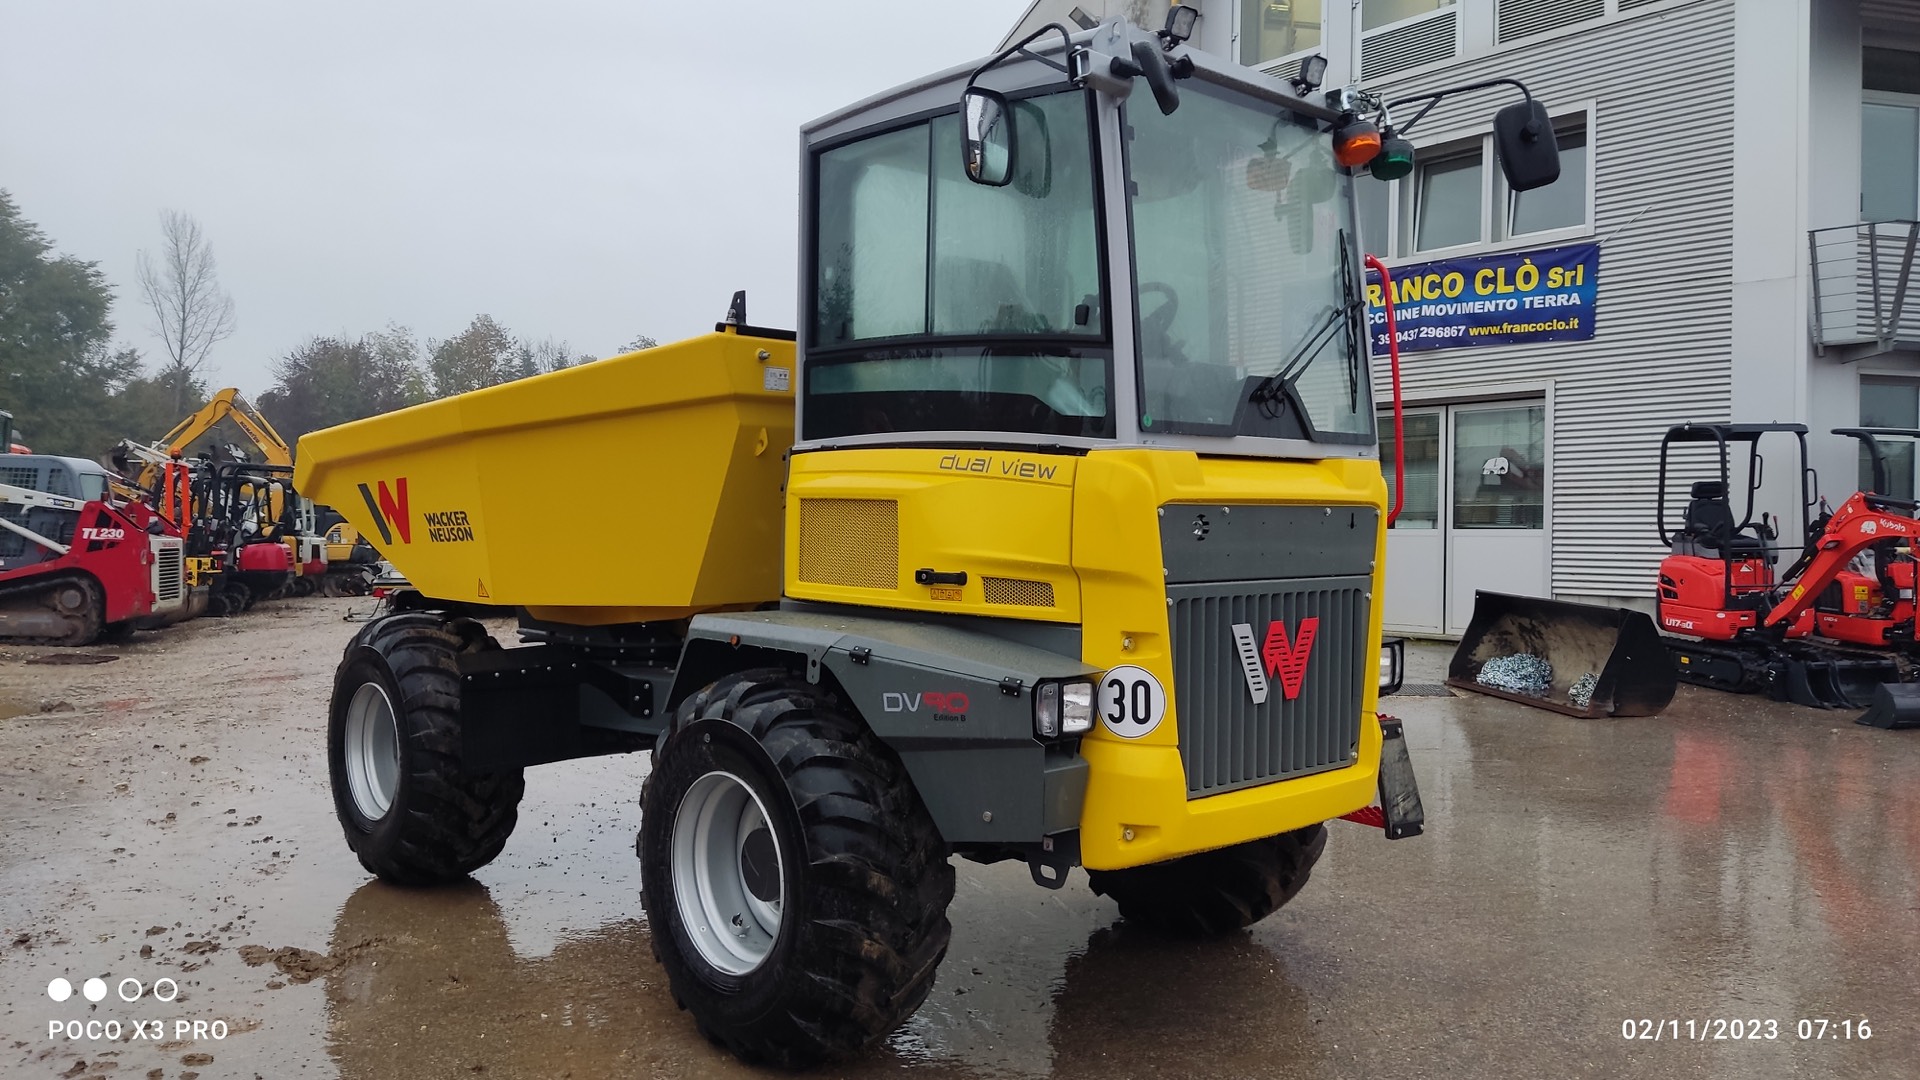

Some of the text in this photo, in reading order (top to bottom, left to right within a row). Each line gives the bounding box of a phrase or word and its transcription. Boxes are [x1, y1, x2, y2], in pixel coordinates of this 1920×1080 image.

[1366, 258, 1584, 307] RANCO CLÒ Srl
[1368, 292, 1582, 325] CCHINE MOVIMENTO TERRA
[1418, 325, 1466, 338] 296867
[1469, 317, 1579, 336] www.francoclo.it
[940, 454, 1057, 480] dual view
[423, 510, 470, 527] WACKER
[1880, 517, 1906, 532] Kubota
[82, 527, 125, 540] TL230
[428, 526, 474, 543] NEUSON
[1107, 679, 1152, 725] 30
[933, 713, 967, 722] Edition B
